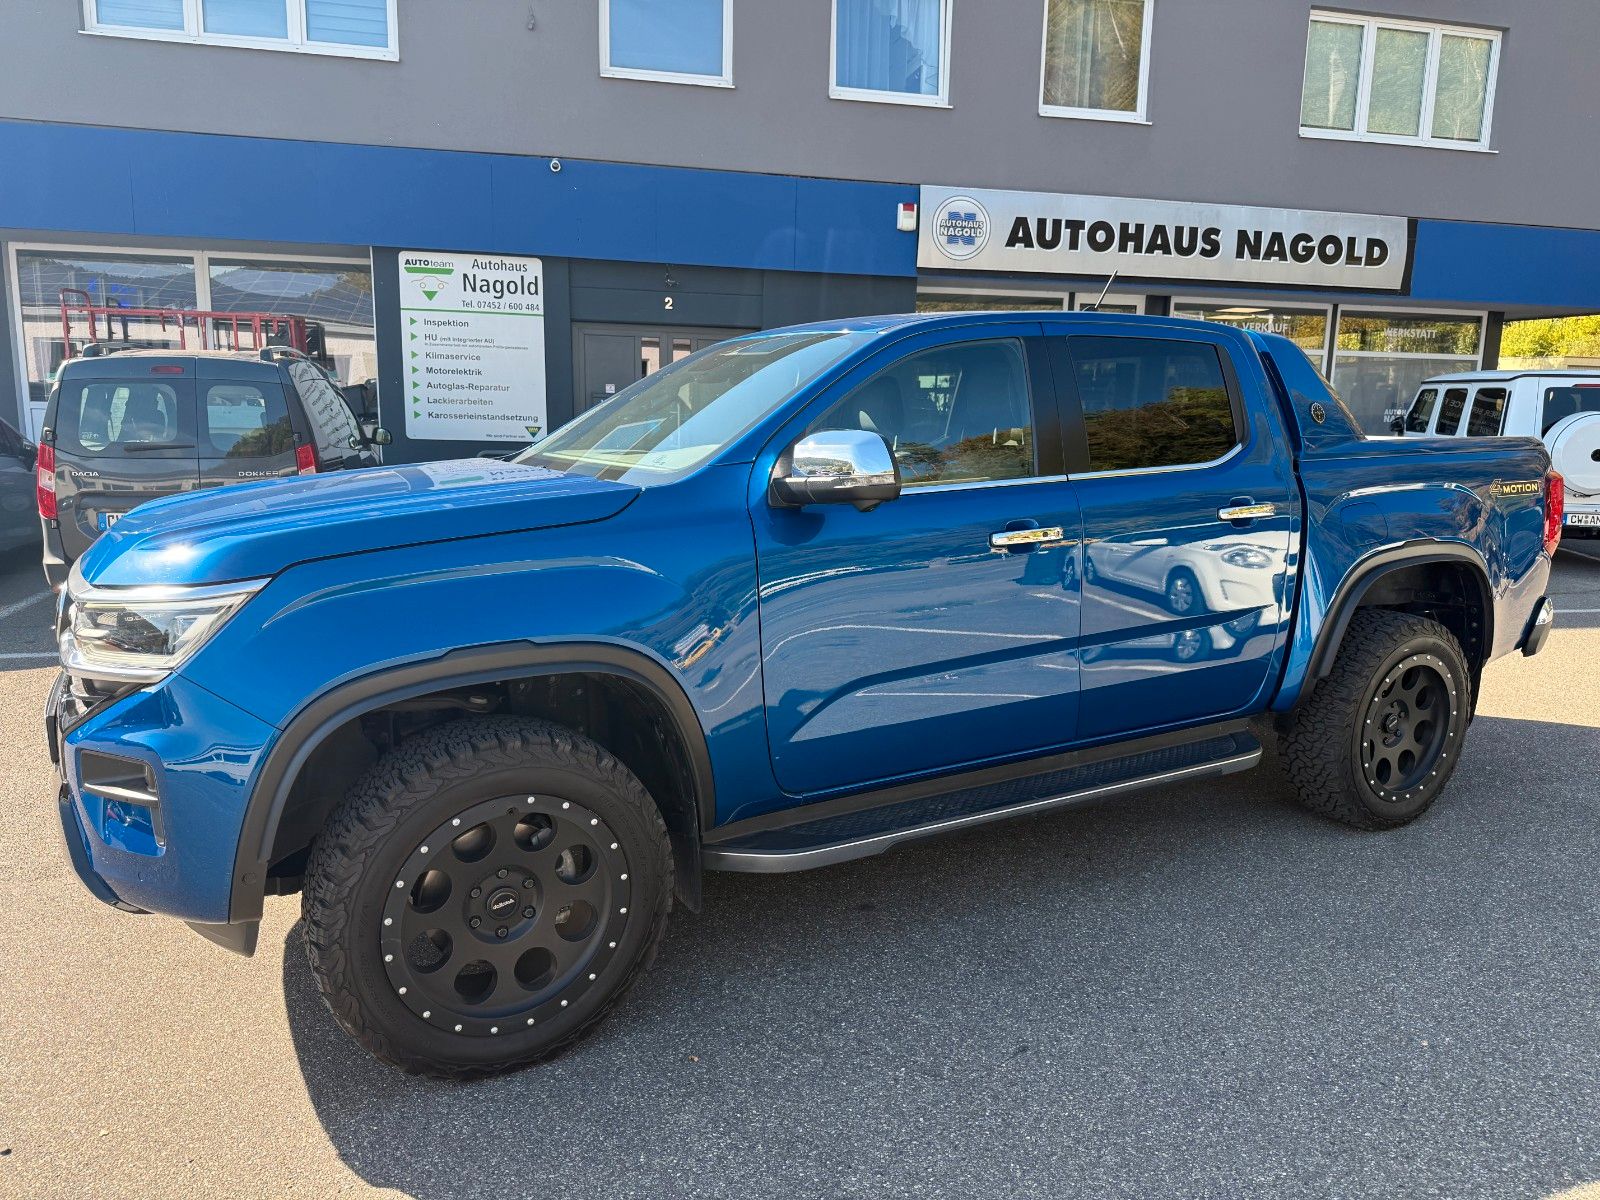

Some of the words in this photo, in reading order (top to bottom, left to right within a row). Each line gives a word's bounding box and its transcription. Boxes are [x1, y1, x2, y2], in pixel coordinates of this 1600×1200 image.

[941, 218, 984, 229] AUTOHAUS
[940, 227, 984, 238] NAGOLD
[1005, 216, 1222, 257] AUTOHAUS
[1236, 229, 1389, 267] NAGOLD
[472, 258, 528, 273] Autohaus
[462, 273, 539, 299] Nagold
[461, 300, 475, 308] Tel.
[477, 301, 501, 309] 07452
[508, 302, 523, 310] 600
[525, 303, 540, 311] 484
[664, 296, 674, 310] 2
[424, 318, 469, 328] Inspektion
[1242, 322, 1289, 334] VERKAUF
[424, 333, 438, 341] HU
[1384, 327, 1438, 338] WERKSTATT
[425, 351, 481, 361] Klimaservice
[425, 366, 483, 376] Motorelektrik
[426, 382, 511, 392] Autoglas-Reparatur
[427, 397, 493, 406] Lackierarbeiten
[427, 411, 539, 423] Karosserieinstandsetzung
[1570, 514, 1584, 524] CW
